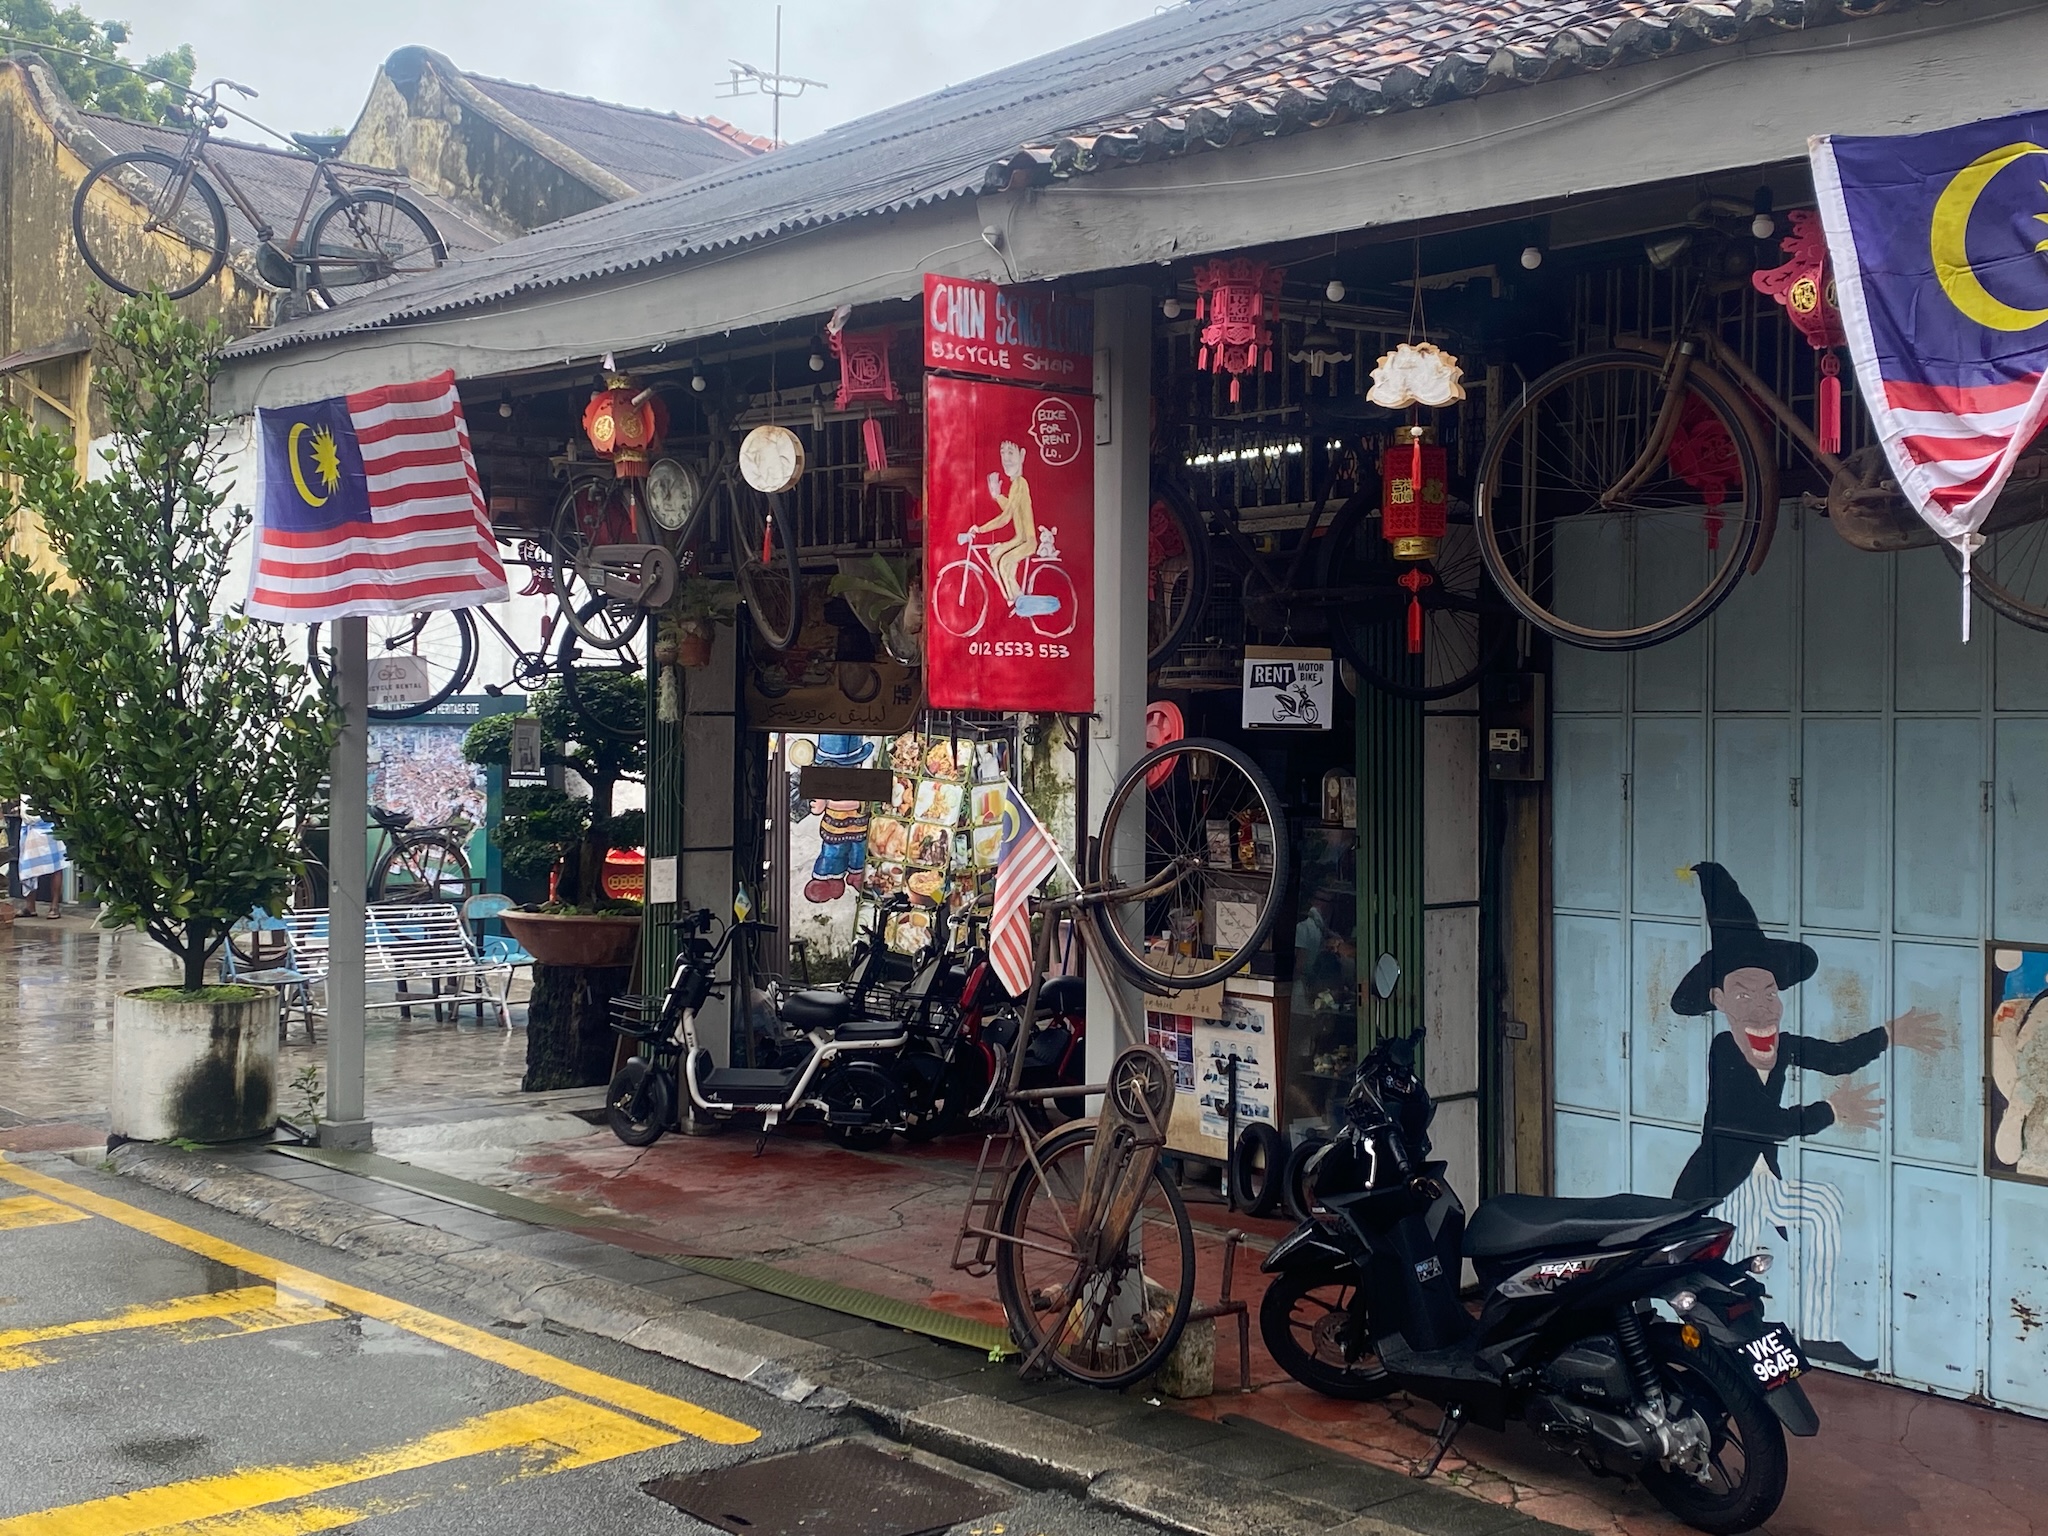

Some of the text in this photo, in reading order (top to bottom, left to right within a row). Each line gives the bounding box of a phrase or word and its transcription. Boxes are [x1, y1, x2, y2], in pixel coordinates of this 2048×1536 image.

[930, 283, 986, 340] CHIN
[995, 291, 1042, 349] SENG
[931, 340, 1075, 375] BICYCLE SHOP
[1037, 409, 1067, 421] BIKE
[1039, 423, 1061, 434] FOR
[1042, 433, 1071, 445] RENT
[968, 641, 1070, 658] 012 5533 553
[1298, 662, 1325, 672] MOTOR
[1254, 666, 1292, 684] RENT
[1300, 672, 1318, 682] BIKE
[395, 682, 422, 690] RENTAL
[437, 703, 465, 715] HERITAGE
[465, 703, 480, 715] SITE
[1746, 1332, 1784, 1361] VKE
[1753, 1348, 1799, 1382] 9645
